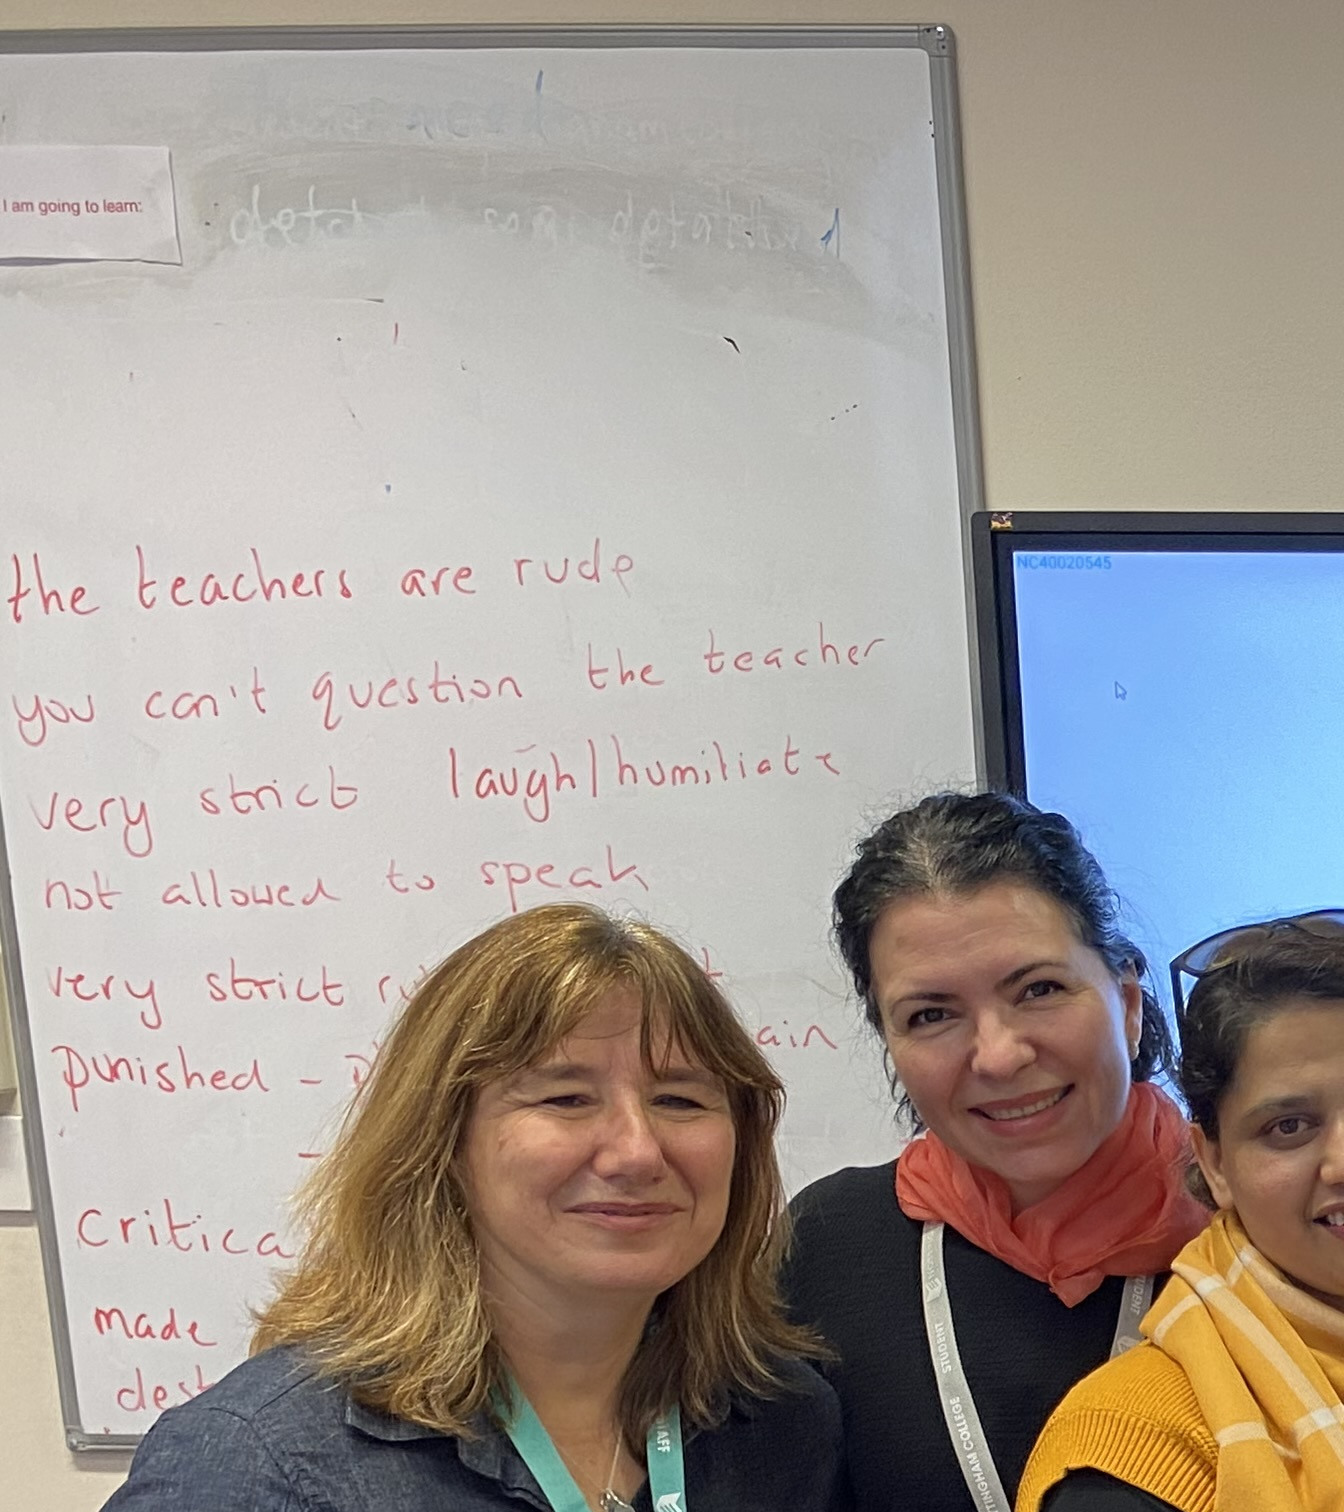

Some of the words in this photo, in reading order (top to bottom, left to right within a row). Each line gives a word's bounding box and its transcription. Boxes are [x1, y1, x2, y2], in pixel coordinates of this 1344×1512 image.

[12, 201, 34, 212] am
[38, 200, 81, 216] going
[85, 200, 99, 213] to
[103, 199, 143, 213] learn:
[8, 553, 99, 623] the
[135, 545, 352, 609] teachers
[401, 566, 476, 597] are
[514, 537, 634, 598] rude
[1016, 555, 1112, 570] NC40020545
[12, 694, 94, 746] you
[145, 666, 266, 718] can't
[312, 660, 522, 730] question
[588, 642, 665, 690] the
[704, 621, 885, 674] teacher
[30, 791, 153, 858] very
[200, 765, 358, 814] strict
[45, 870, 122, 911] not
[162, 869, 341, 908] allowed
[386, 859, 435, 893] to
[480, 845, 650, 913] speak
[47, 966, 163, 1030] very
[206, 957, 345, 1007] strict
[935, 1322, 951, 1374] STUDENT
[949, 1396, 975, 1457] COLLEGE
